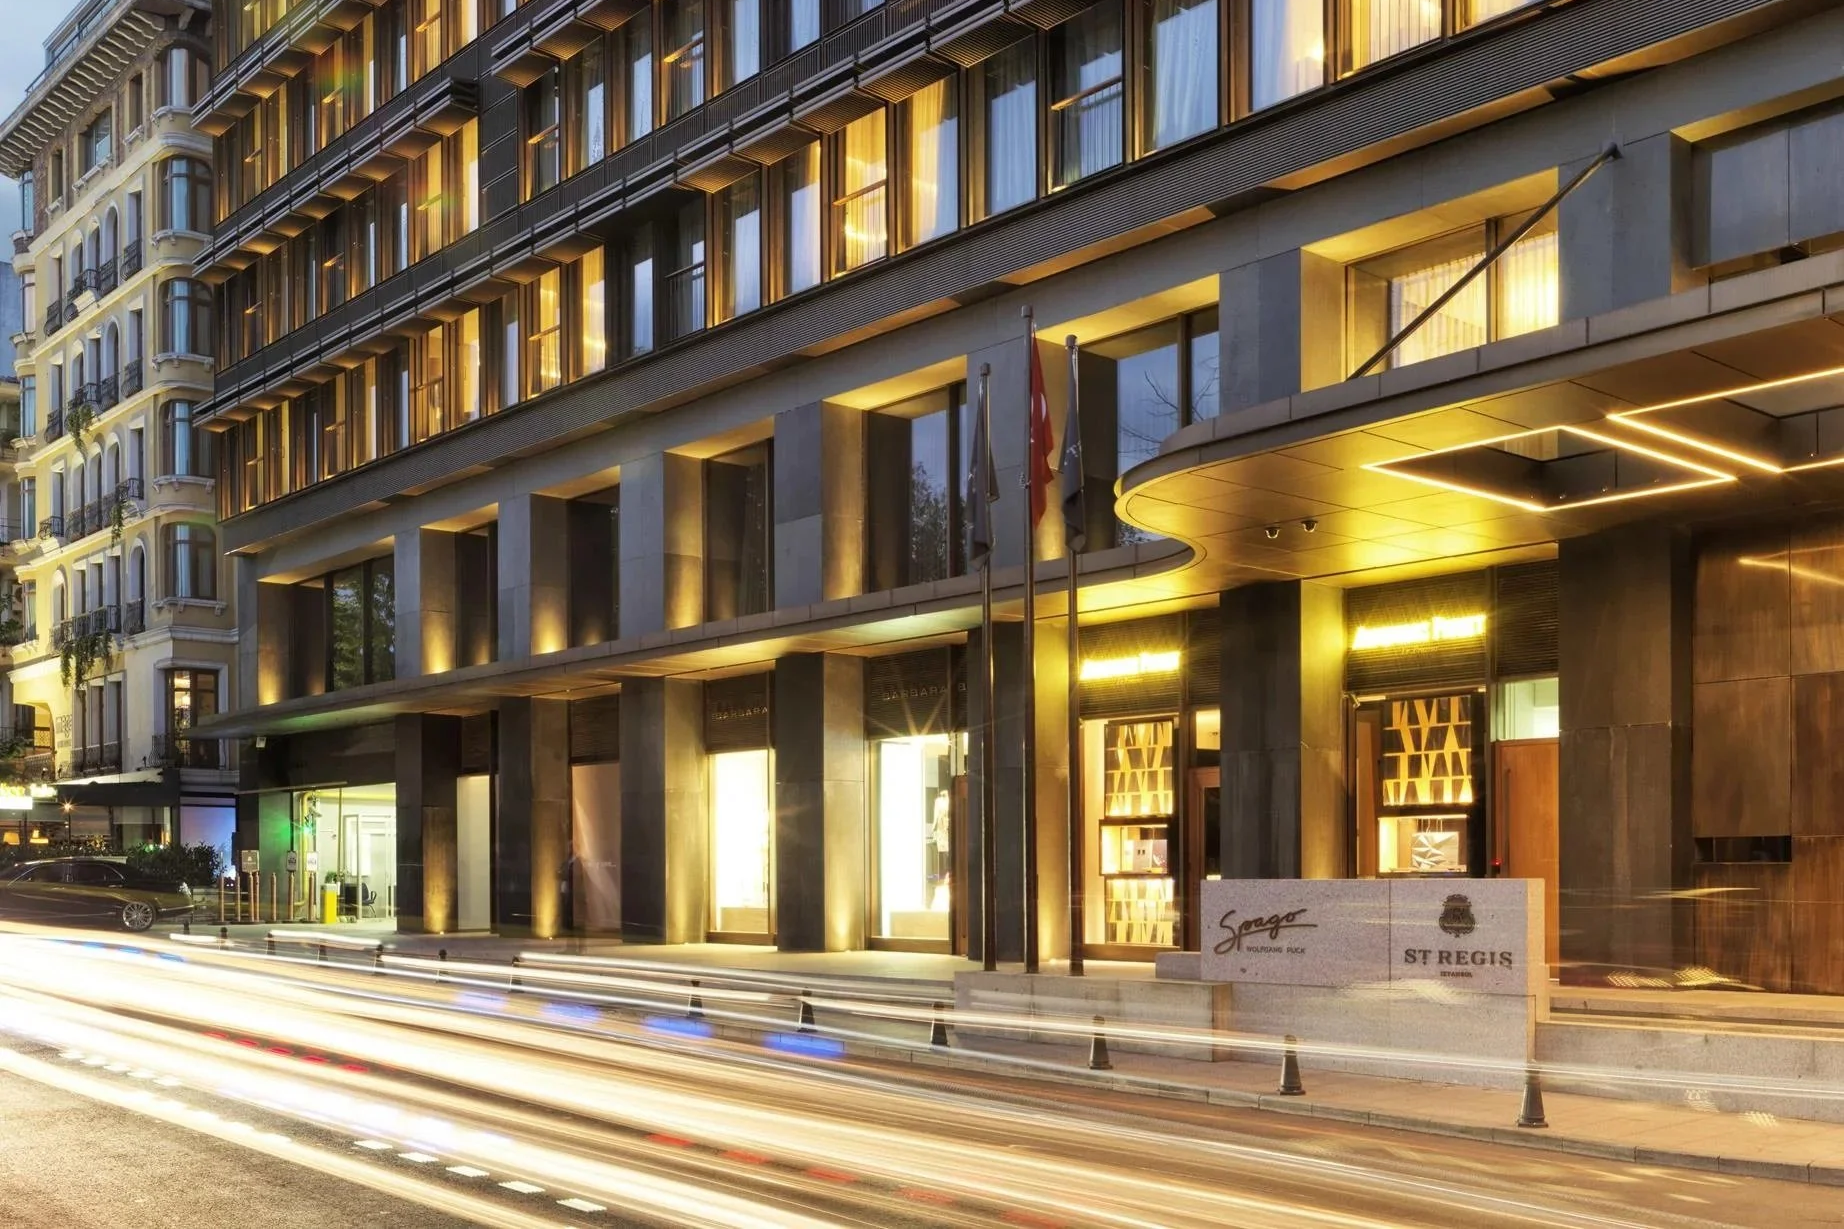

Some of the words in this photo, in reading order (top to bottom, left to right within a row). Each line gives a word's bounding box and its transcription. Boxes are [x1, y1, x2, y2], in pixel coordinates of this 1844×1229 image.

[1213, 908, 1318, 955] Spago
[1246, 945, 1283, 954] WOLFGANG
[1286, 946, 1306, 954] PUCK
[1437, 950, 1513, 968] REGIS
